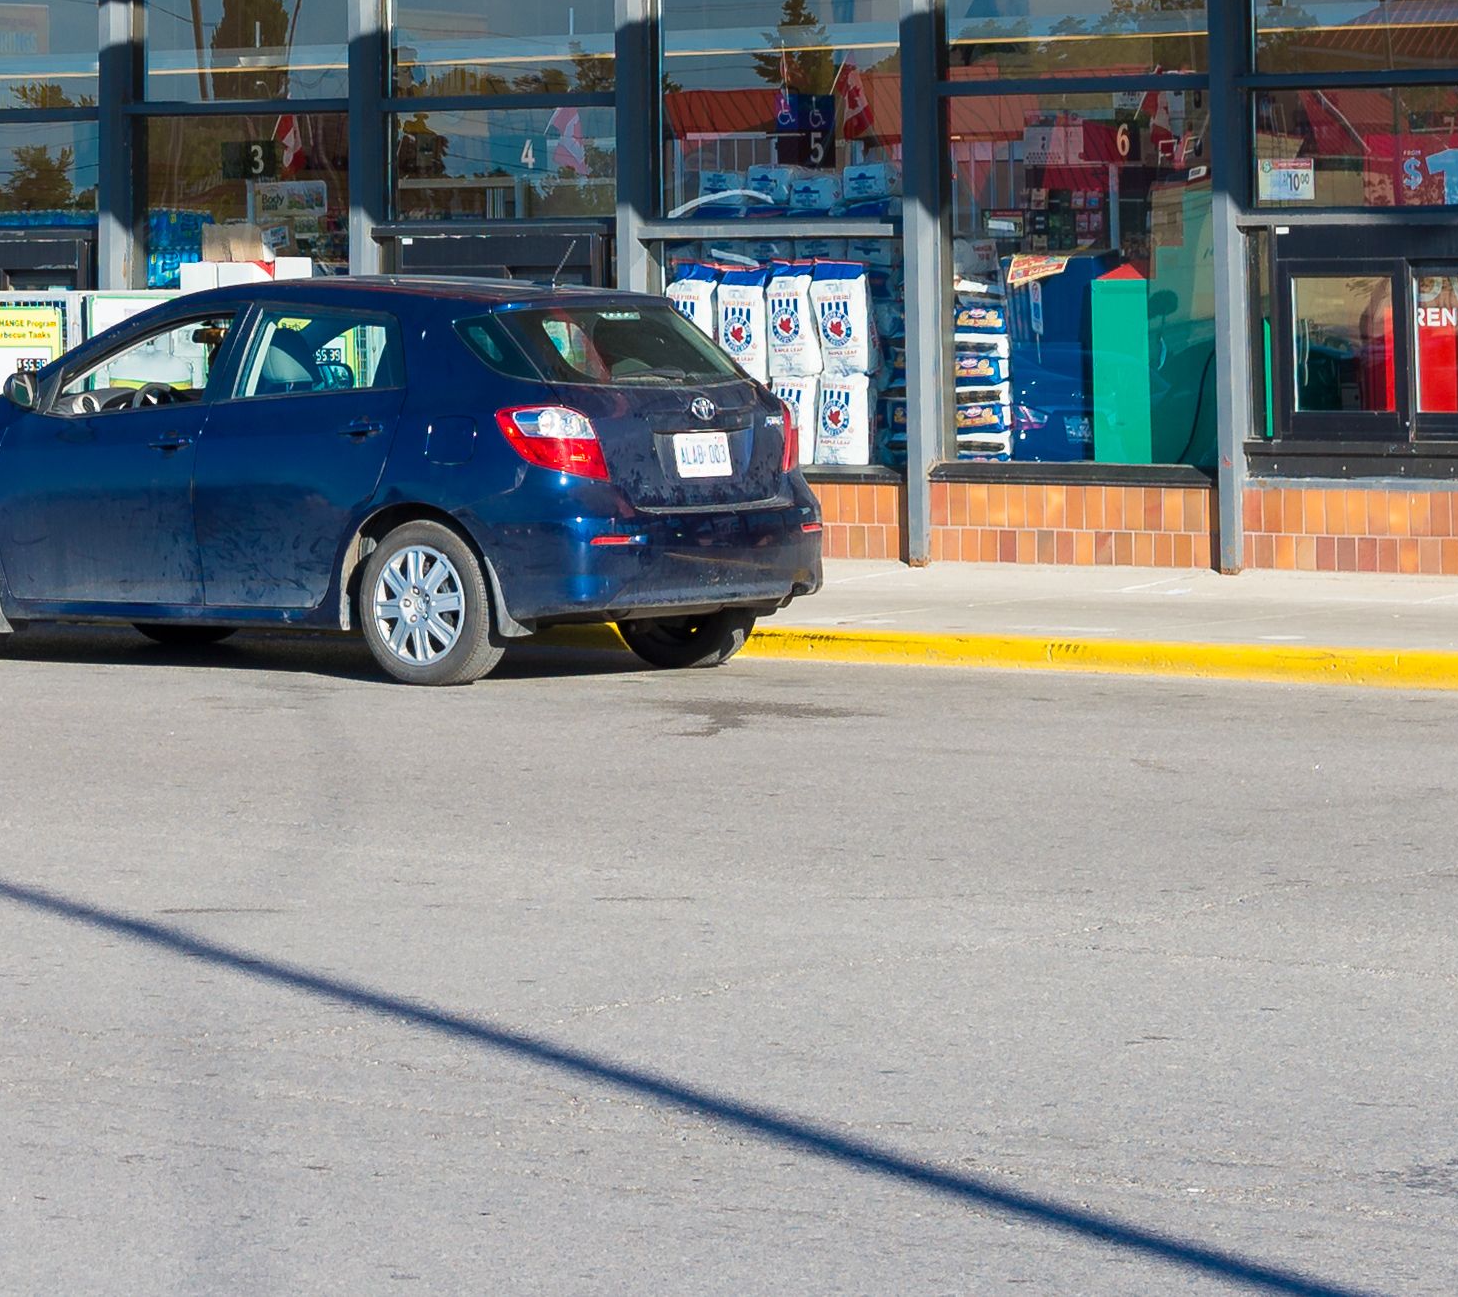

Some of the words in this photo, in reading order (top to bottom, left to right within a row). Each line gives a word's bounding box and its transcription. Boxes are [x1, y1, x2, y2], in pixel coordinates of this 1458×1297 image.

[520, 138, 536, 169] 4
[809, 131, 825, 164] 5
[1116, 123, 1131, 156] 6
[250, 144, 265, 174] 3
